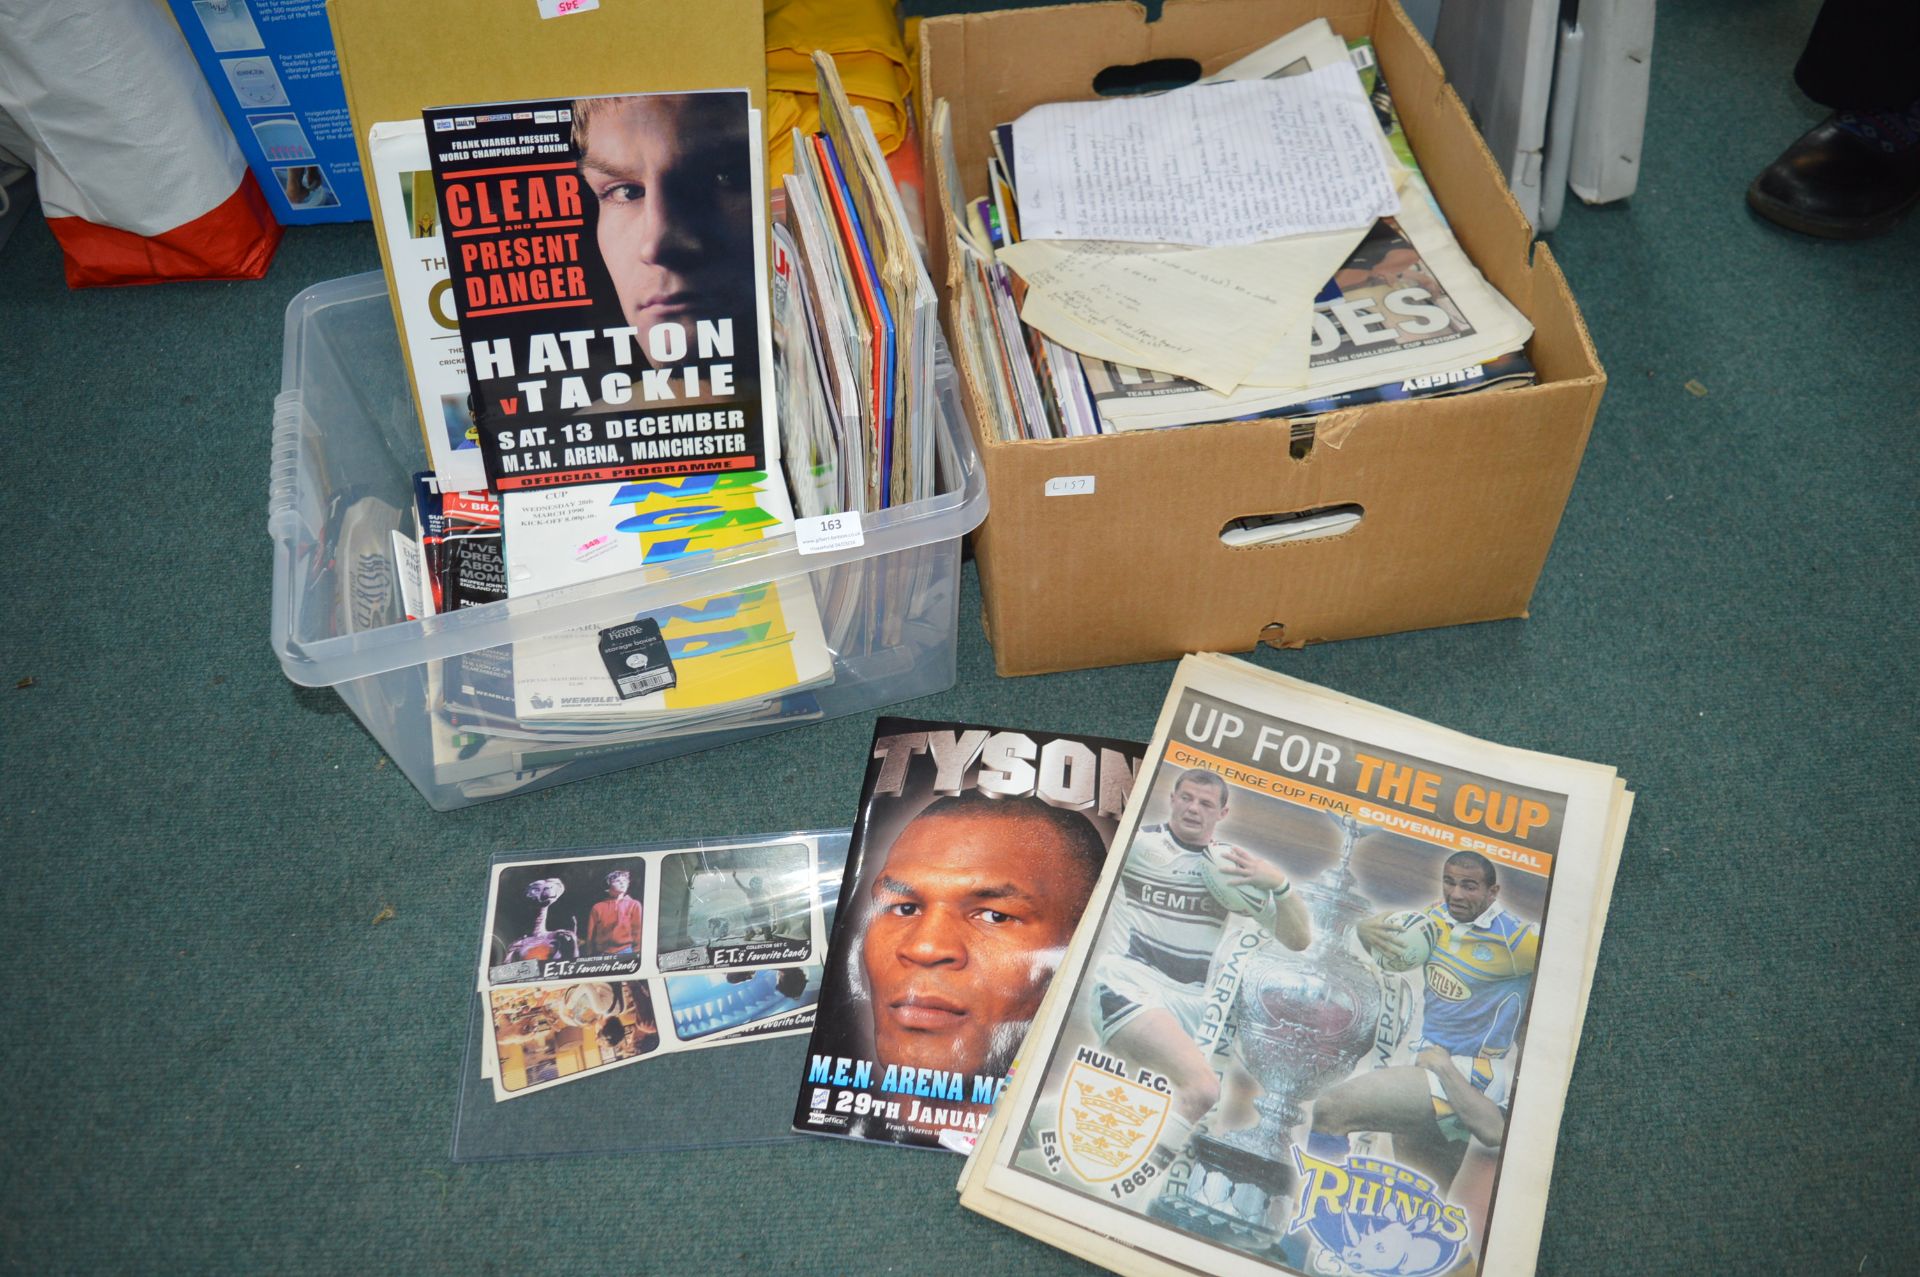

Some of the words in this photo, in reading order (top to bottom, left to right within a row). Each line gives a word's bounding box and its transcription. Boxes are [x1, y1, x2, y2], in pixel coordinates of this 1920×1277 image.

[439, 150, 470, 163] WORLD
[472, 146, 535, 159] CHAMPIONSHIP
[538, 143, 569, 154] BOXING
[452, 140, 480, 150] FRANK
[480, 137, 516, 148] WARREN
[519, 133, 560, 145] PRESENTS
[446, 175, 582, 227] CLEAR
[505, 223, 531, 231] AND
[461, 233, 579, 272] PRESENT
[465, 266, 586, 308] DANGER
[471, 318, 735, 380] HATTON
[1350, 345, 1401, 360] CHALLENGE
[1404, 342, 1422, 351] CUP
[1424, 333, 1462, 347] HISTORY
[500, 398, 518, 415] v
[518, 364, 735, 413] TACKIE
[1401, 364, 1484, 392] RUGBY
[1126, 390, 1152, 398] TEAM
[1153, 386, 1195, 397] RETURNS
[498, 427, 555, 450] SAT.
[561, 423, 592, 442] 13
[606, 410, 744, 439] DECEMBER
[502, 454, 557, 473] M.E.N.
[565, 443, 624, 466] ARENA,
[632, 434, 746, 460] MANCHESTER
[521, 472, 603, 486] OFFICIAL
[612, 461, 732, 477] PROGRAMME
[522, 501, 576, 513] WEDNESDAY
[545, 491, 568, 500] CUP
[521, 518, 562, 527] KICK-OFF
[533, 510, 566, 519] MARCH
[820, 519, 842, 532] 163
[460, 583, 491, 593] ENGLAND
[605, 642, 633, 653] storage
[633, 636, 657, 646] boxes
[609, 627, 643, 641] home
[475, 690, 515, 702] WEMBLEY
[561, 696, 622, 704] WEMBLEY
[874, 730, 1143, 823] TYSON
[1184, 702, 1245, 750] UP
[1251, 725, 1341, 784] FOR
[1353, 753, 1443, 814] THE
[1453, 782, 1551, 841] CUP
[1174, 750, 1269, 790] CHALLENGE
[1272, 781, 1307, 800] CUP
[1308, 791, 1353, 815] FINAL
[1358, 806, 1456, 844] SOUVENIR
[1459, 834, 1542, 869] SPECIAL
[747, 949, 781, 961] Favorite
[783, 946, 808, 959] Candy
[576, 962, 611, 974] Favorite
[611, 960, 637, 972] Candy
[808, 1054, 874, 1089] M.E.N.
[881, 1064, 964, 1101] ARENA
[1077, 1047, 1126, 1078] HULL
[1138, 1070, 1172, 1095] F.C.
[835, 1090, 900, 1120] 29TH
[824, 1117, 844, 1125] office
[885, 1122, 906, 1133] Frank
[907, 1125, 933, 1136] Warren
[1041, 1131, 1061, 1173] Est.
[1111, 1162, 1156, 1199] 1865
[1351, 1158, 1431, 1192] LEEDS
